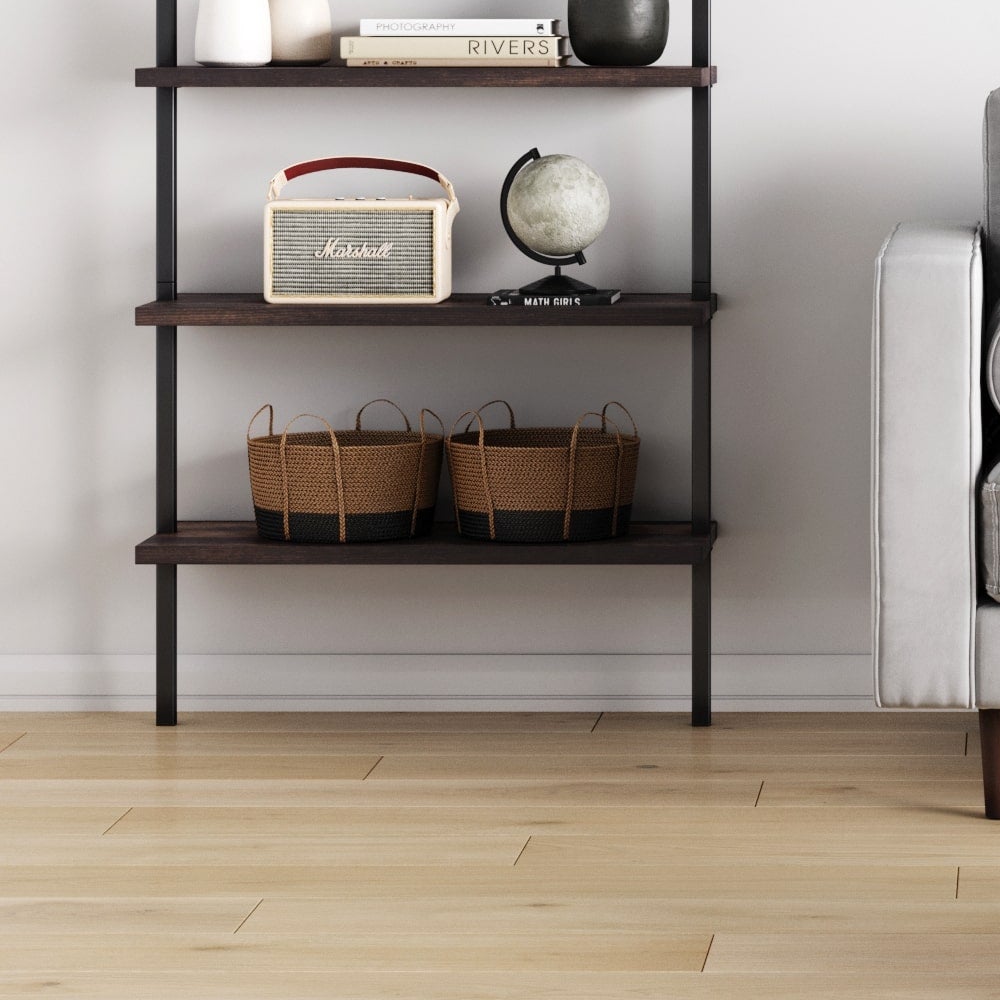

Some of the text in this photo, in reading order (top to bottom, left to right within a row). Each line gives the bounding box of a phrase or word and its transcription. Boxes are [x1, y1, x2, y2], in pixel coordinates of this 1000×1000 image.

[376, 22, 456, 32] PHOTOGRAPHY
[468, 39, 549, 55] RIVERS
[314, 237, 394, 258] Marshall
[524, 297, 550, 306] MATH
